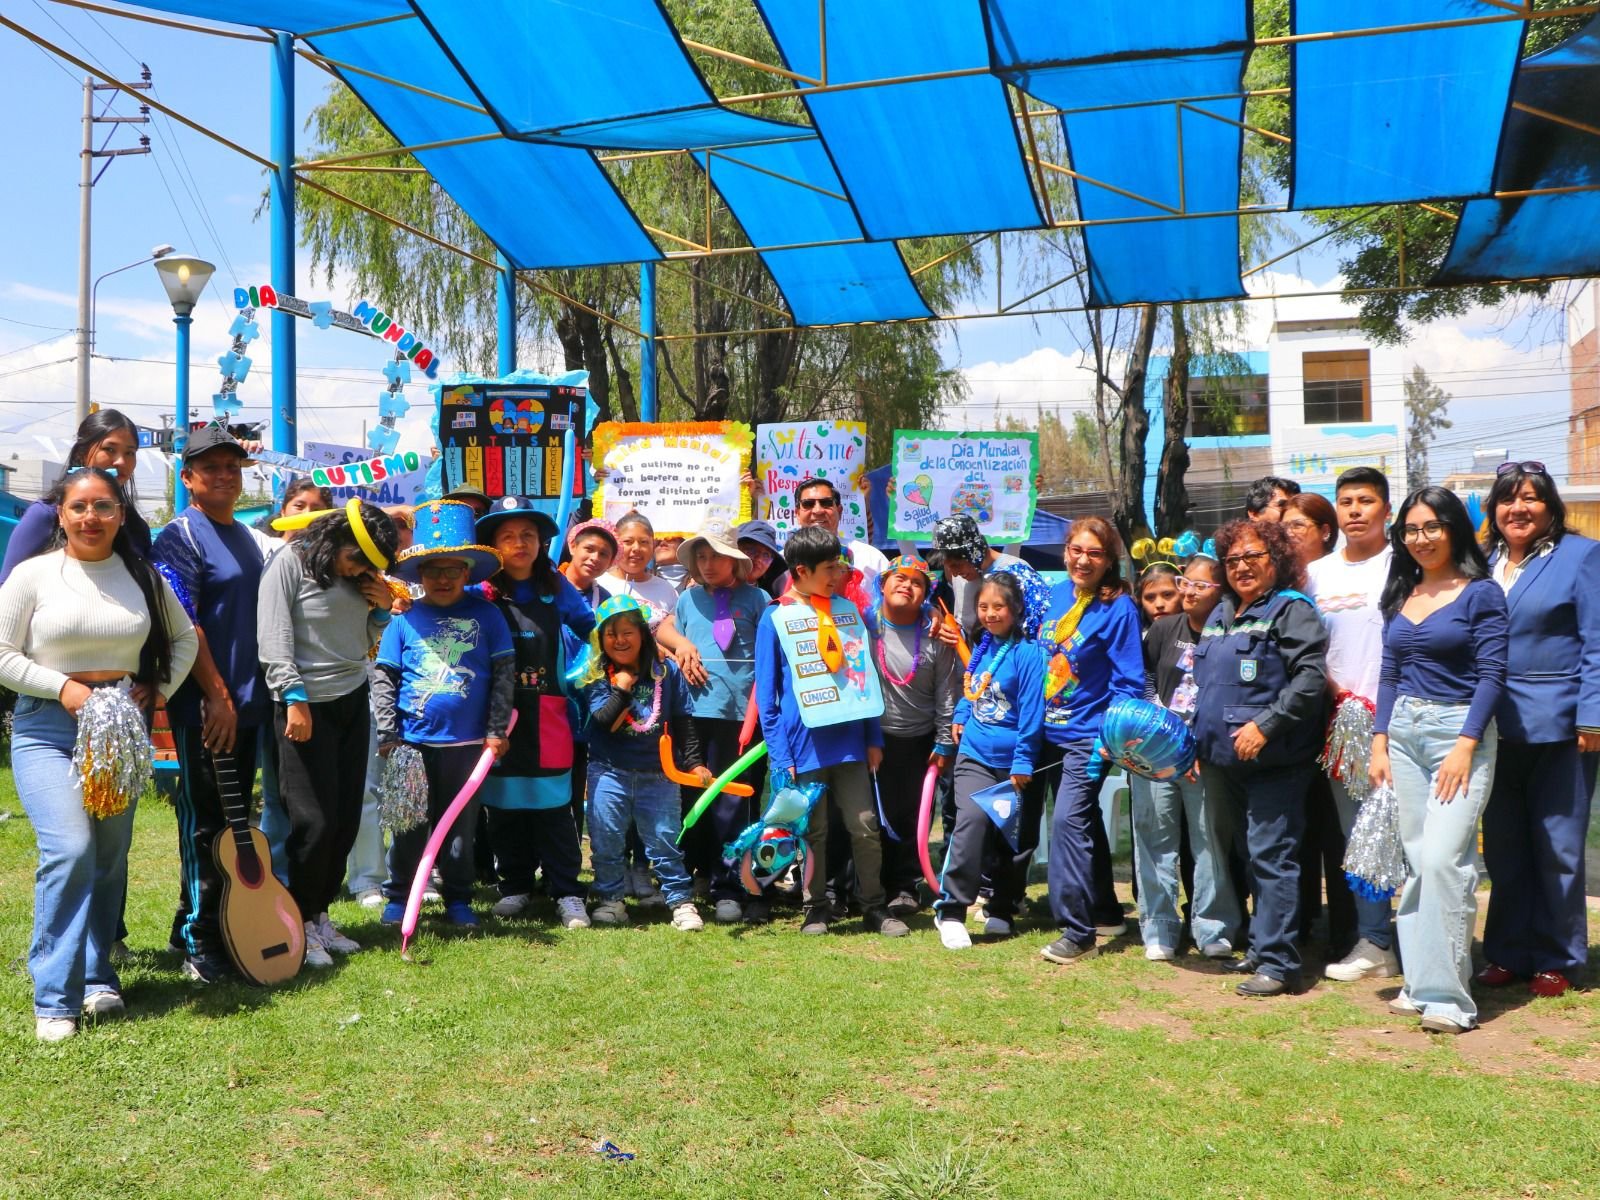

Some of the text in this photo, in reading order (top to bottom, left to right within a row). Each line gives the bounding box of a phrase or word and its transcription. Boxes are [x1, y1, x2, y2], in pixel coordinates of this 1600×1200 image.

[234, 286, 440, 379] DIA MUNDIAL
[766, 428, 855, 461] Autismo
[978, 440, 1020, 457] Mundial
[313, 451, 419, 487] AUTISMO
[623, 464, 634, 473] El
[641, 461, 683, 469] autismo
[687, 463, 701, 471] no
[920, 456, 1027, 471] de la Concientización
[613, 475, 634, 484] una
[641, 473, 679, 482] barrera
[700, 474, 721, 483] una
[617, 485, 720, 497] forma distinta de
[632, 497, 710, 508] ver el mundo
[904, 507, 931, 521] Salud
[788, 621, 807, 631] SER
[800, 643, 816, 653] ME
[804, 691, 835, 703] UNICO
